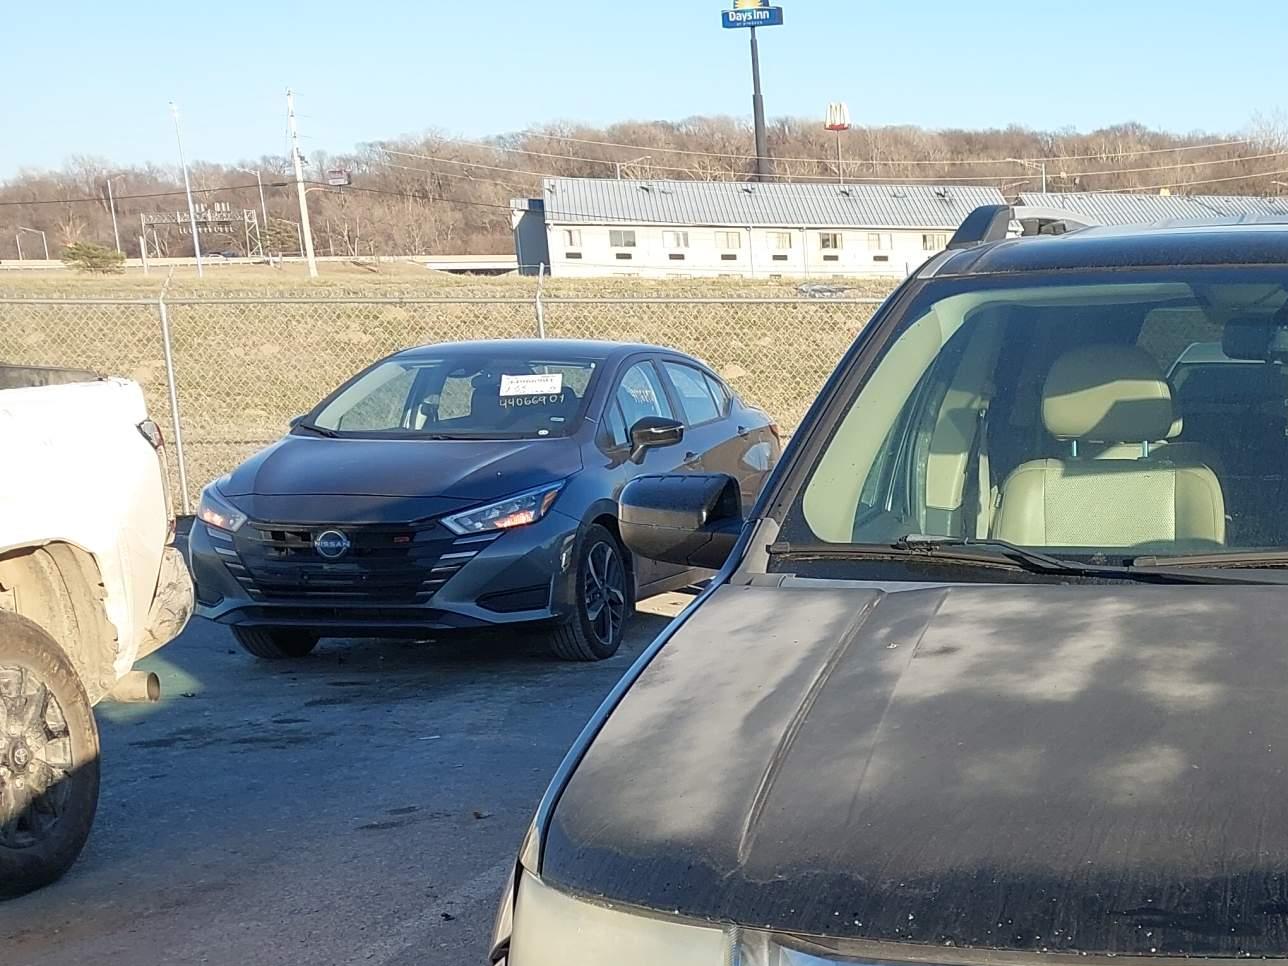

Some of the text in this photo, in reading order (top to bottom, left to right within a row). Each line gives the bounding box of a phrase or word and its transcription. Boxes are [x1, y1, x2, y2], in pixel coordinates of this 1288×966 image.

[728, 10, 769, 21] Days Inn
[314, 540, 351, 548] NISSAN
